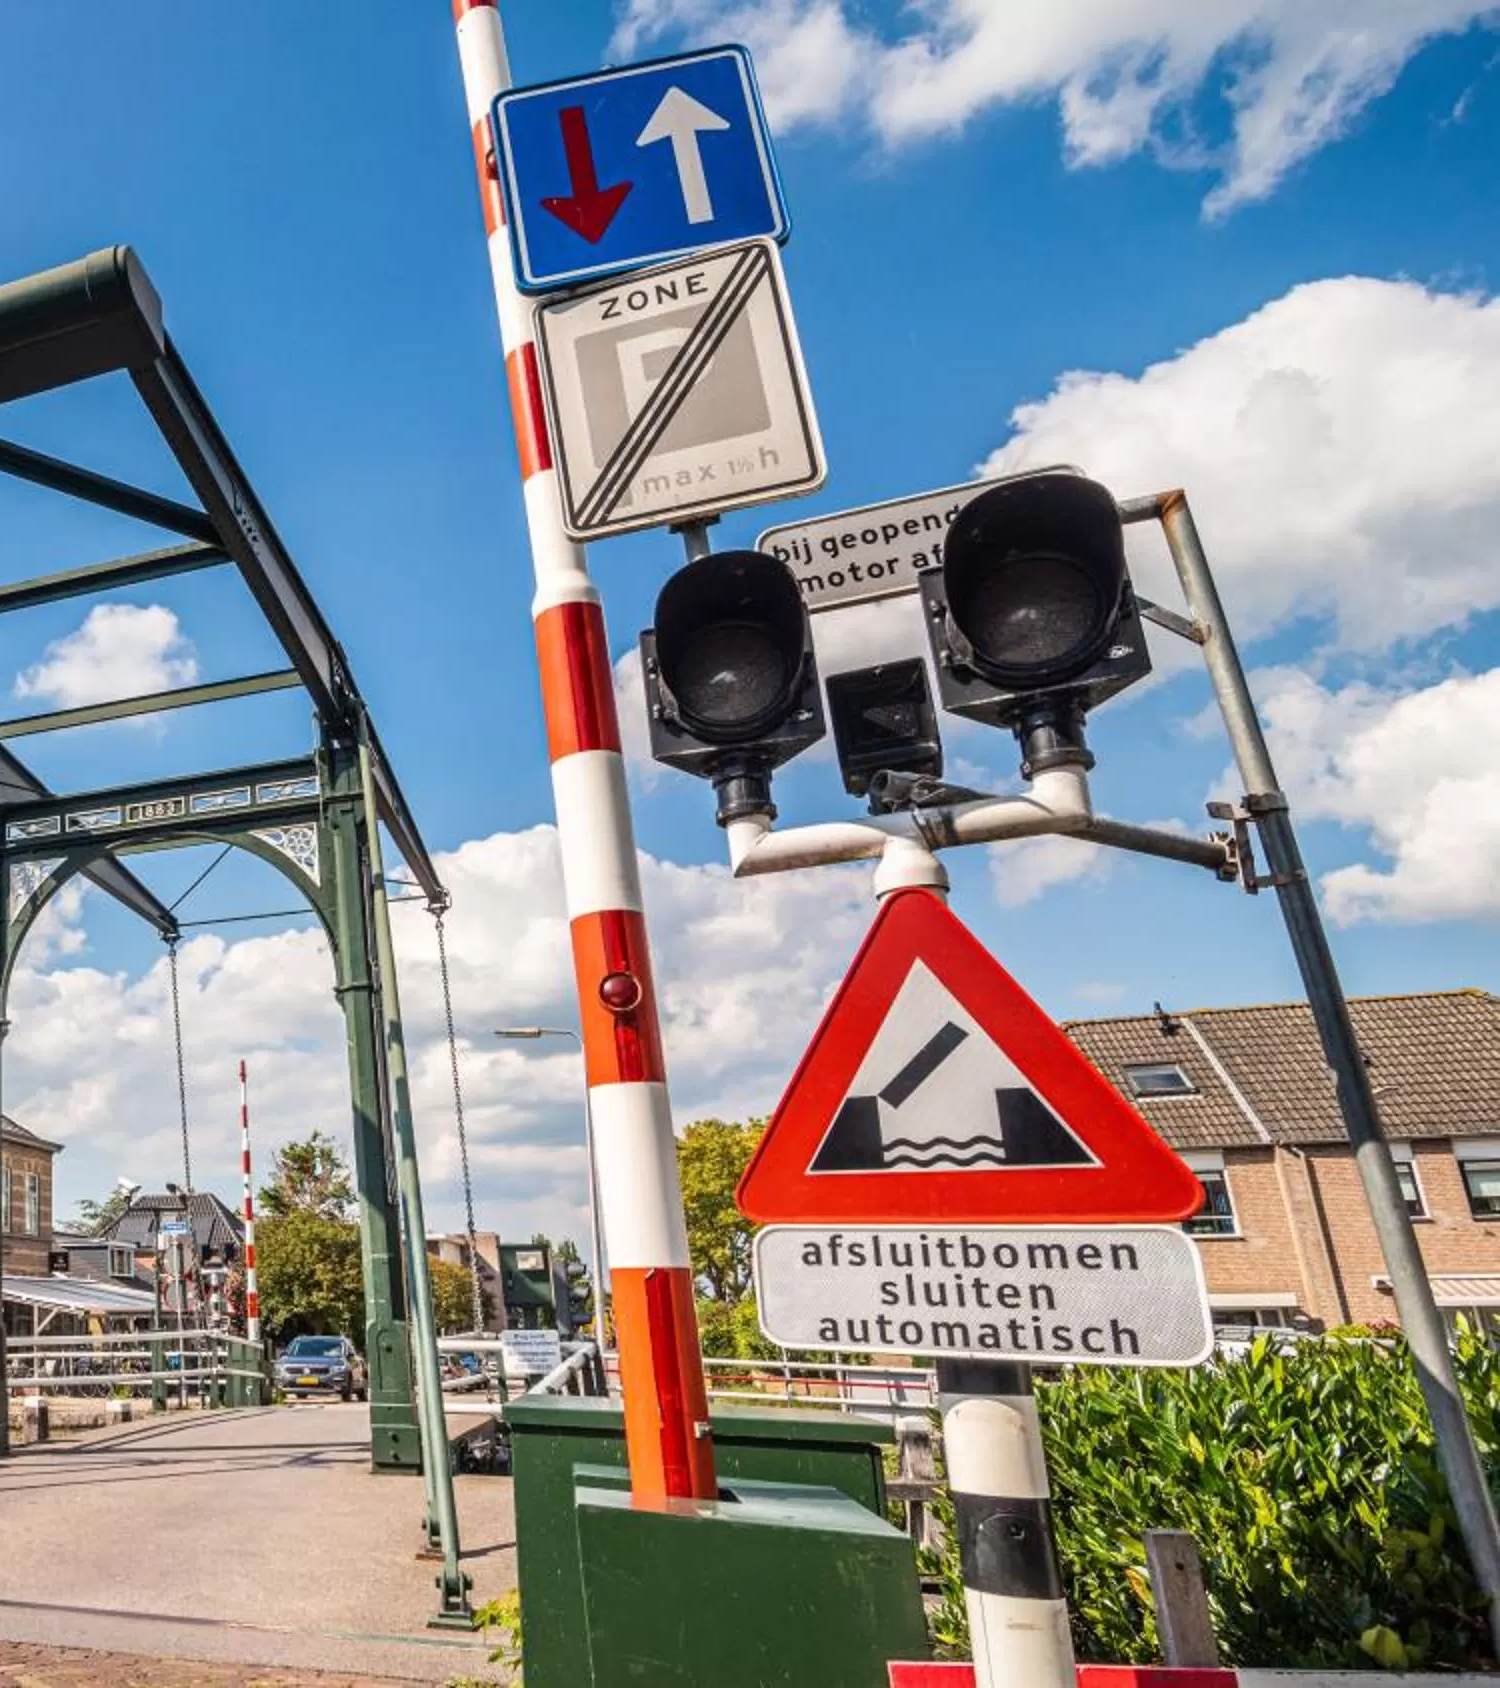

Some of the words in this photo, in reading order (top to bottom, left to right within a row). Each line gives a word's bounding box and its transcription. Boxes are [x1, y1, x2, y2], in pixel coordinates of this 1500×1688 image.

[599, 272, 709, 321] ZONE
[642, 462, 716, 496] max
[758, 446, 780, 470] h
[773, 537, 813, 565] bij
[820, 504, 960, 559] geopend
[797, 557, 899, 593] motor
[139, 801, 175, 818] 1883
[801, 1234, 1140, 1271] afsluitbomen
[881, 1274, 1056, 1310] sluiten
[819, 1316, 1141, 1355] automatisch
